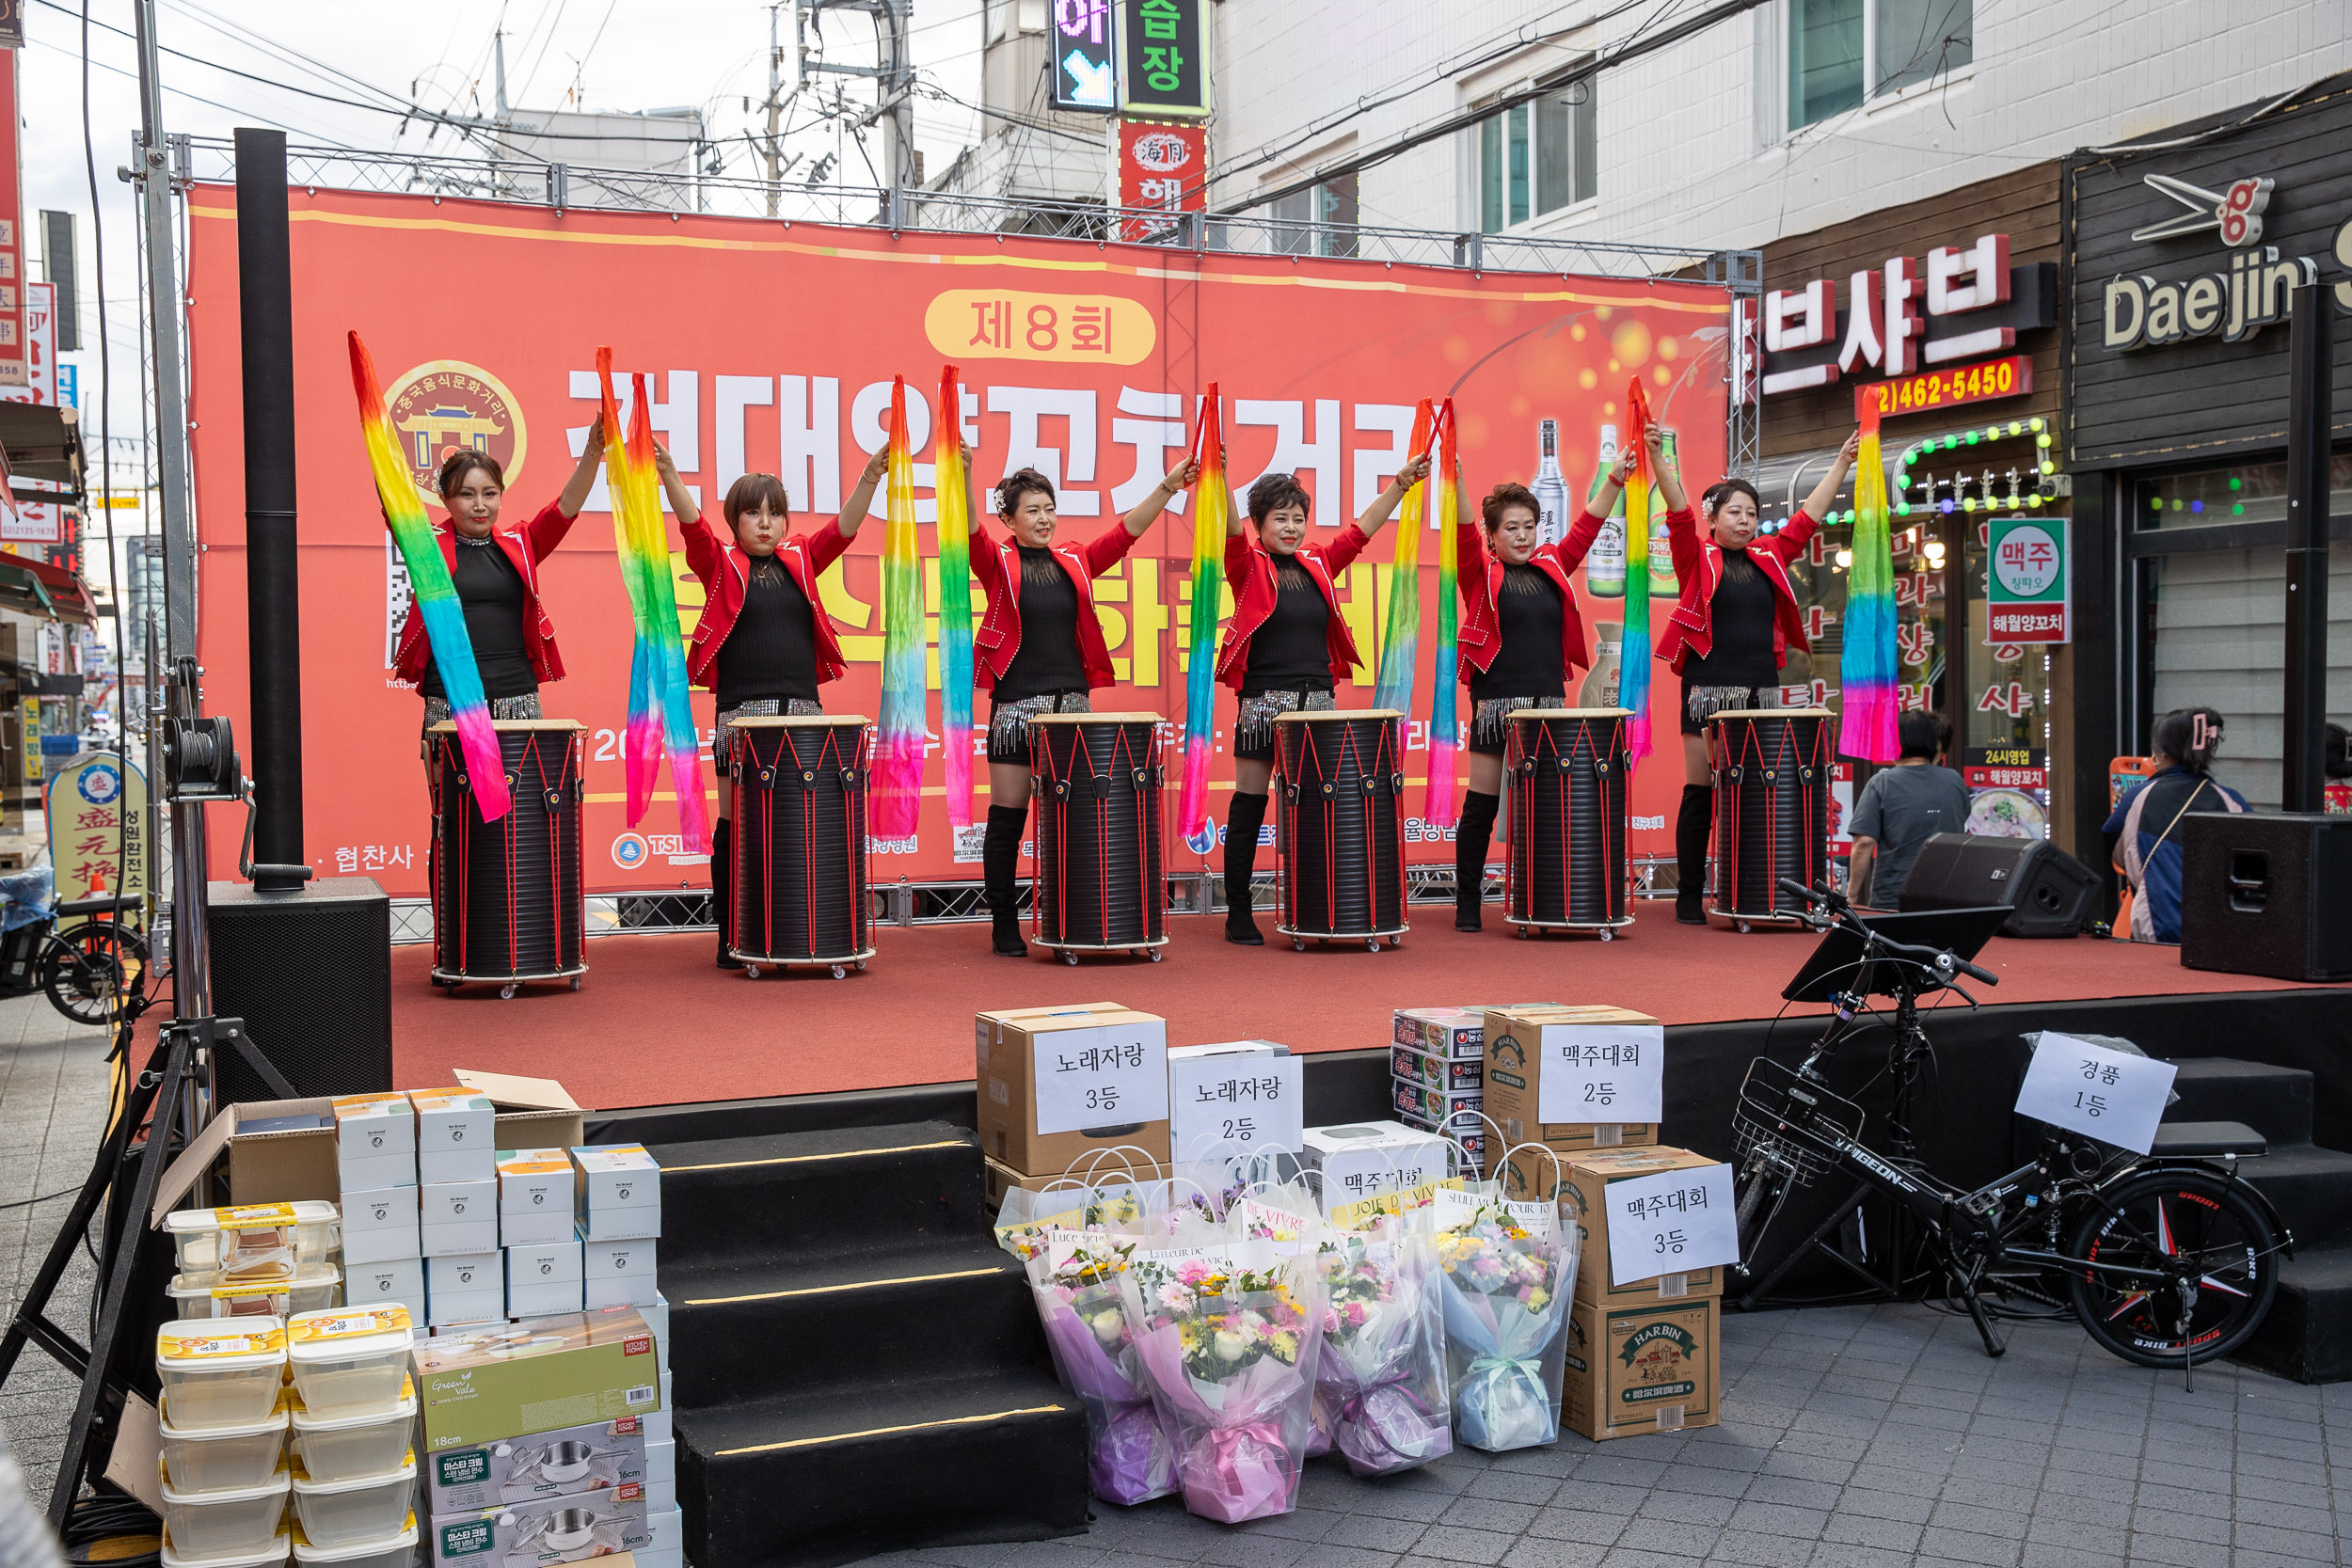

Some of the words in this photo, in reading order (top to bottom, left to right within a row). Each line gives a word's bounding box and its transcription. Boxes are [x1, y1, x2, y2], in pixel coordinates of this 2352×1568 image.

[2105, 248, 2299, 347] Daejin
[397, 372, 505, 415] 중국음식문화거리
[1880, 362, 2012, 414] 2)462-5450
[2001, 542, 2053, 572] 맥주
[2010, 577, 2044, 590] 칭따오
[1992, 613, 2062, 633] 해월양꼬치
[25, 700, 40, 756] 노래방
[1985, 750, 2030, 765] 24시영업
[1989, 768, 2042, 786] 해월양꼬치
[125, 810, 143, 888] 성원환전소
[334, 845, 414, 873] 협찬사
[1497, 1036, 1519, 1053] HARBIN
[1562, 1044, 1640, 1068] 맥주대회
[1056, 1042, 1146, 1072] 노래자랑
[2079, 1059, 2121, 1085] 경품
[1086, 1086, 1120, 1110] 3등
[1195, 1075, 1282, 1102] 노래자랑
[1583, 1083, 1616, 1105] 2등
[2073, 1091, 2107, 1117] 1등
[1223, 1117, 1257, 1141] 2등
[1628, 1185, 1708, 1221] 맥주대회
[1053, 1232, 1078, 1243] Luce
[1654, 1228, 1688, 1254] 3등
[625, 1339, 648, 1348] KITCHEN
[1634, 1325, 1682, 1346] HARBIN
[432, 1377, 463, 1392] Green
[455, 1384, 476, 1395] Vale
[1632, 1384, 1684, 1400] 哈尔滨啤酒
[434, 1435, 462, 1448] 18cm
[619, 1470, 641, 1479] 16cm
[622, 1536, 644, 1544] 16cm
